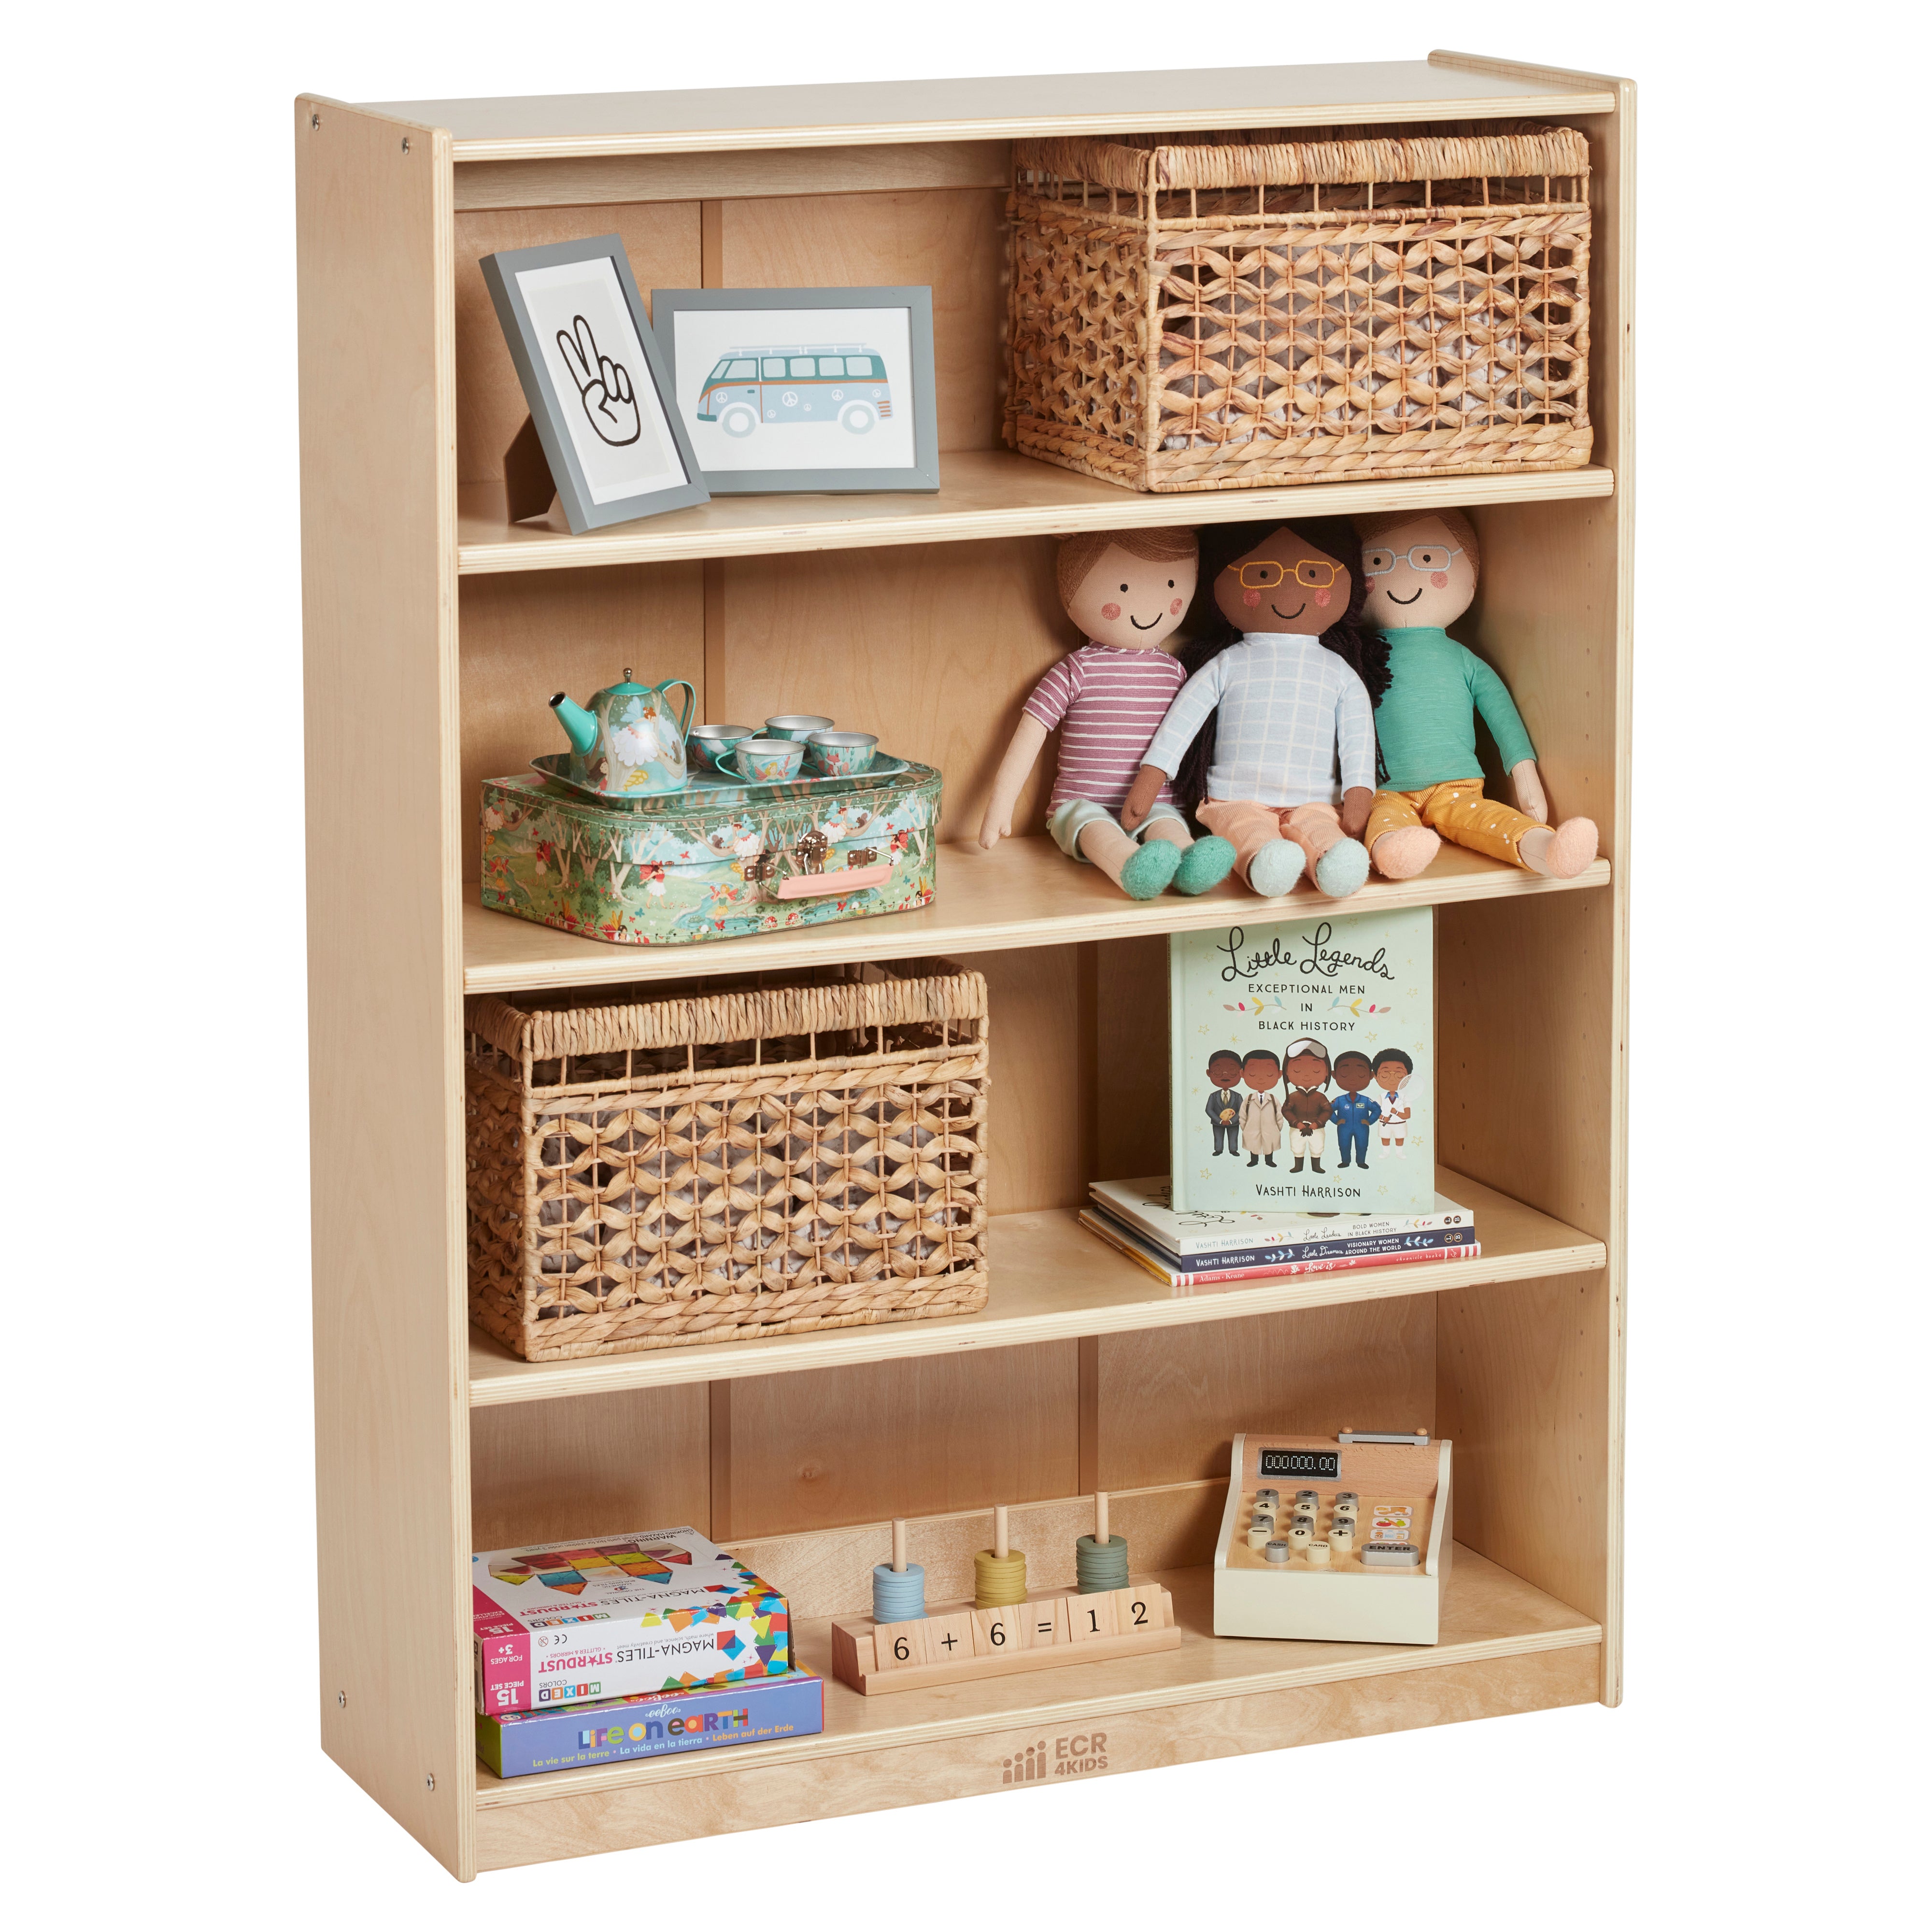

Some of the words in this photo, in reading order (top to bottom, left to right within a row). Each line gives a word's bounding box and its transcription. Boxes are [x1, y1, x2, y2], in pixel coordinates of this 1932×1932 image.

[1217, 926, 1297, 982] Little
[1300, 922, 1395, 980] Legends
[1248, 984, 1333, 994] EXCEPTIONAL
[1339, 984, 1365, 994] MEN
[1301, 1003, 1313, 1012] IN
[1259, 1021, 1295, 1031] BLACK
[1300, 1021, 1356, 1032] HISTORY
[1256, 1184, 1296, 1197] VASHTI
[1302, 1185, 1361, 1198] HARRISON
[1196, 1241, 1218, 1250] VASHTI
[1221, 1237, 1254, 1248] HARRISON
[1347, 1239, 1377, 1248] VISIONARY
[1196, 1258, 1219, 1267] VASHTI
[1222, 1255, 1255, 1265] HARRISON
[1199, 1273, 1221, 1282] Adams
[1304, 1262, 1325, 1274] Love
[1326, 1261, 1336, 1270] is
[626, 1535, 677, 1544] WARNING:
[600, 1589, 706, 1606] MAGNA-TILES
[532, 1613, 609, 1628] MIXED
[894, 1636, 910, 1660] 6
[990, 1622, 1006, 1646] 6
[498, 1644, 513, 1655] 3+
[616, 1638, 714, 1662] MAGNA-TILES
[490, 1657, 508, 1665] AGES
[504, 1680, 524, 1689] PIECE
[539, 1679, 567, 1689] COLORS
[497, 1688, 519, 1706] 15
[540, 1683, 600, 1701] MIXED
[628, 1720, 664, 1742] on
[545, 1757, 559, 1765] vie
[578, 1752, 586, 1761] la
[588, 1750, 610, 1760] terre
[620, 1747, 630, 1755] La
[632, 1744, 652, 1753] vida
[668, 1740, 676, 1748] la
[678, 1737, 703, 1747] tierra
[712, 1732, 739, 1742] Leben
[741, 1729, 755, 1737] auf
[757, 1727, 772, 1735] der
[774, 1723, 795, 1733] Erde
[1056, 1732, 1107, 1760] ECR
[1054, 1755, 1108, 1776] 4KIDS
